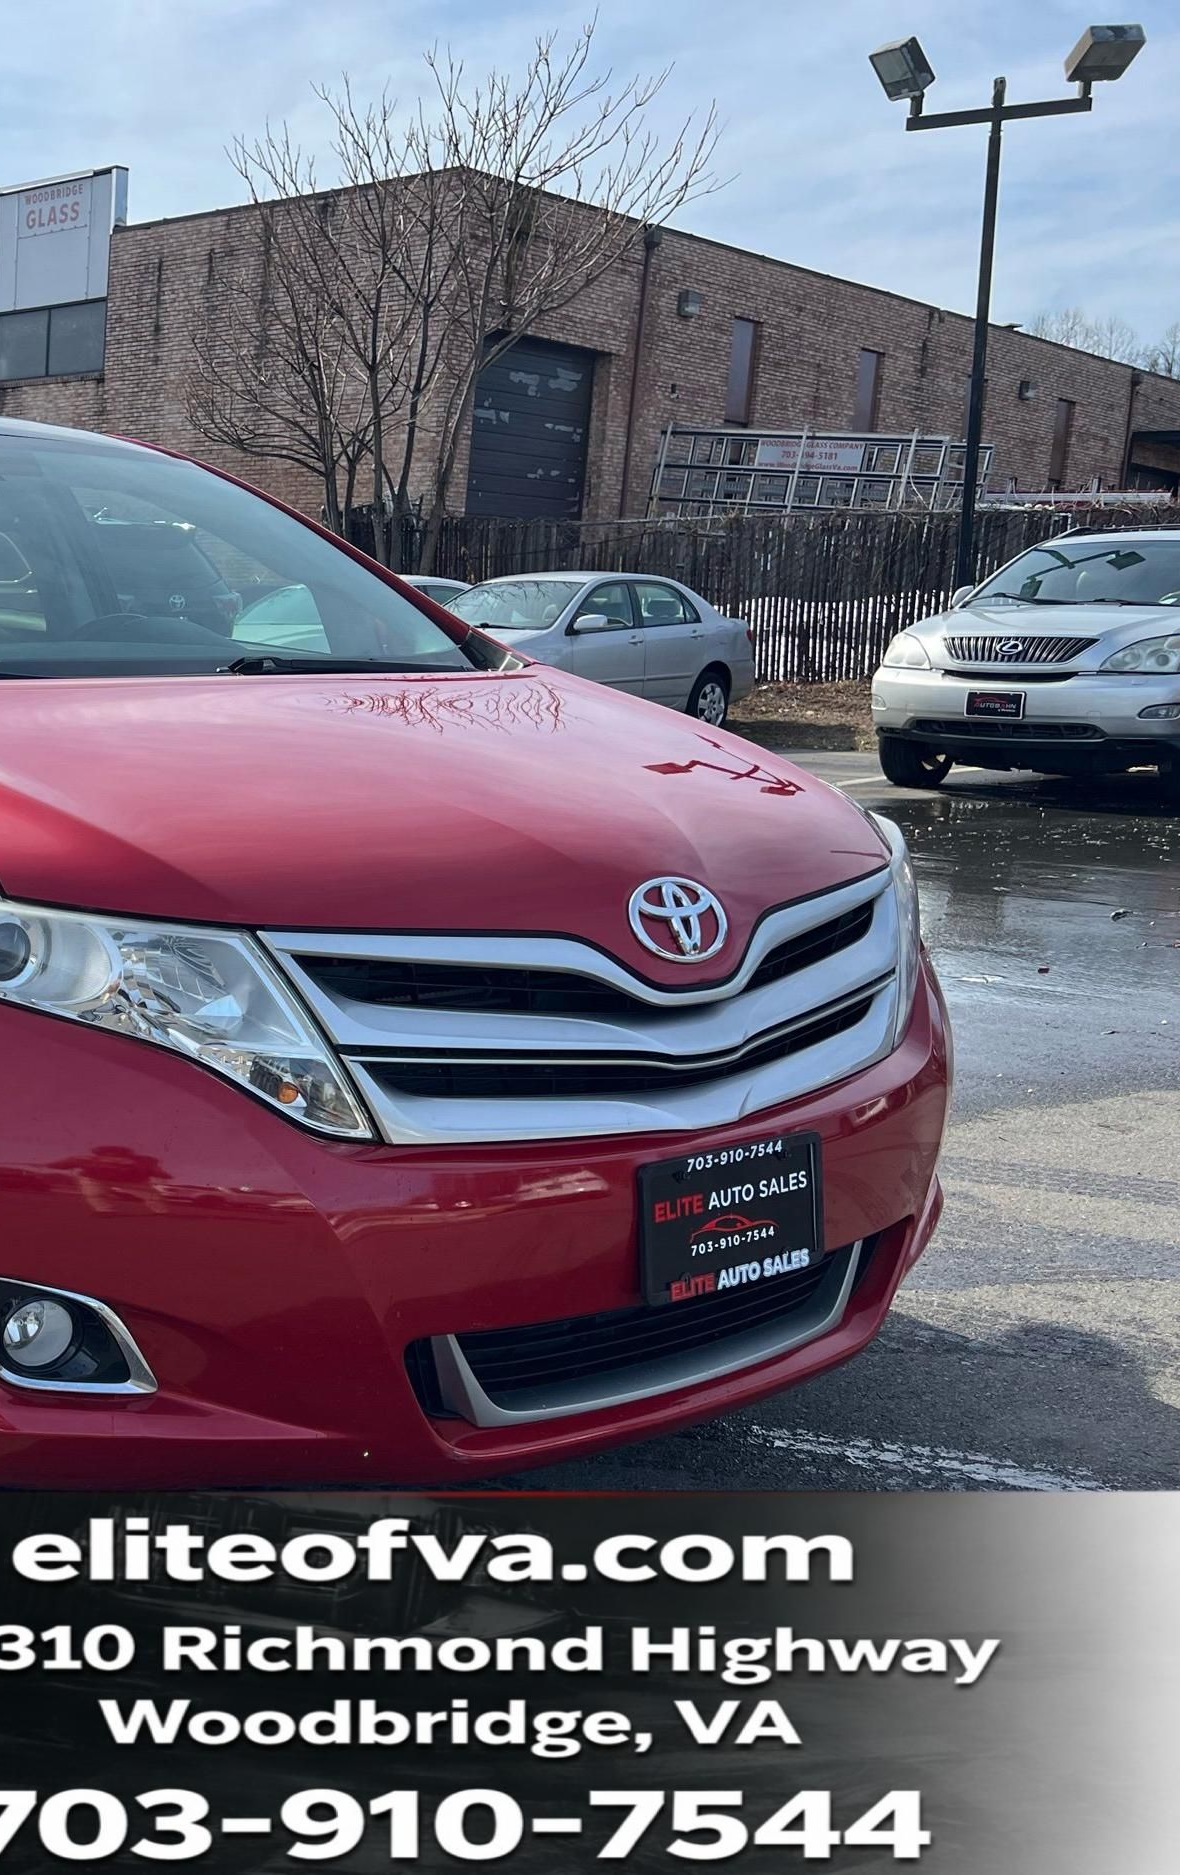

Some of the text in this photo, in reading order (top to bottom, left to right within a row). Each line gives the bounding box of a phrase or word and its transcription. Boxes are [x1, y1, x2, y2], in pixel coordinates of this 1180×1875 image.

[25, 184, 84, 205] WOODBRIDGE
[26, 202, 80, 230] GLASS
[761, 439, 804, 448] WOODBRIDG
[829, 441, 864, 450] COMPANY
[781, 450, 838, 460] 703-94-5181
[687, 1140, 782, 1172] 703-910-7544
[654, 1171, 807, 1223] ELITE AUTO SALES
[691, 1226, 775, 1257] 703-910-7544
[671, 1248, 810, 1302] ELITE AUTO SALES
